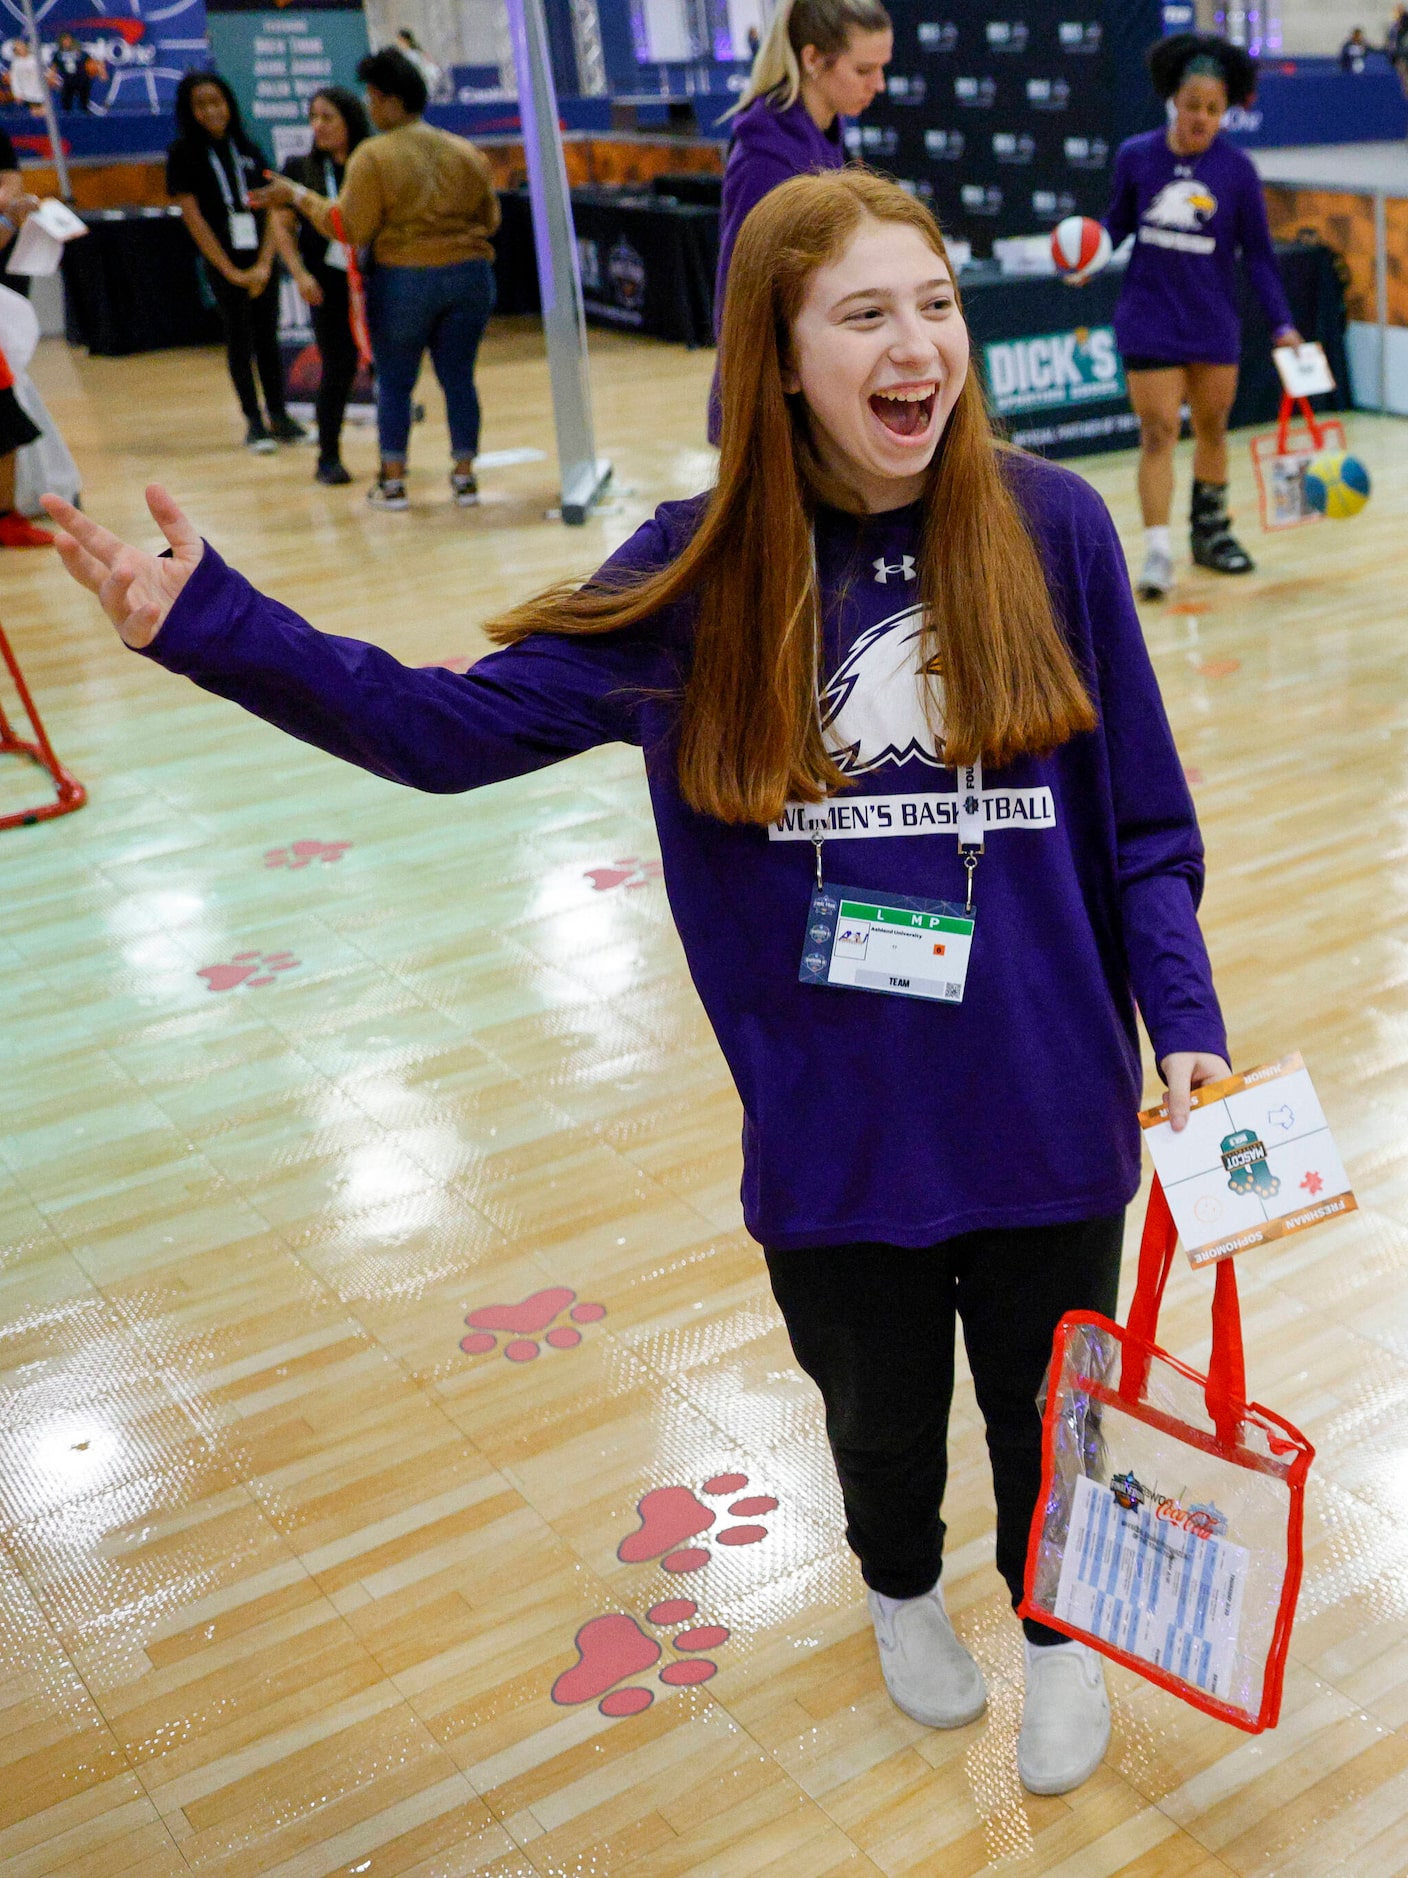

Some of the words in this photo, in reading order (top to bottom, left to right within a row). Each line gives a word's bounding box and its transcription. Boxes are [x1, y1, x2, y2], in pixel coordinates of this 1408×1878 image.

[986, 329, 1118, 396] DICK'S
[902, 795, 1052, 827] BASTBALL
[911, 914, 922, 926] M
[929, 917, 940, 928] P
[889, 977, 910, 988] TEAM
[1243, 1063, 1282, 1086] JUNIOR
[1227, 1146, 1264, 1171] MASCOT
[1286, 1200, 1346, 1229] FRESHMAN
[1195, 1231, 1264, 1263] SOPHOMORE
